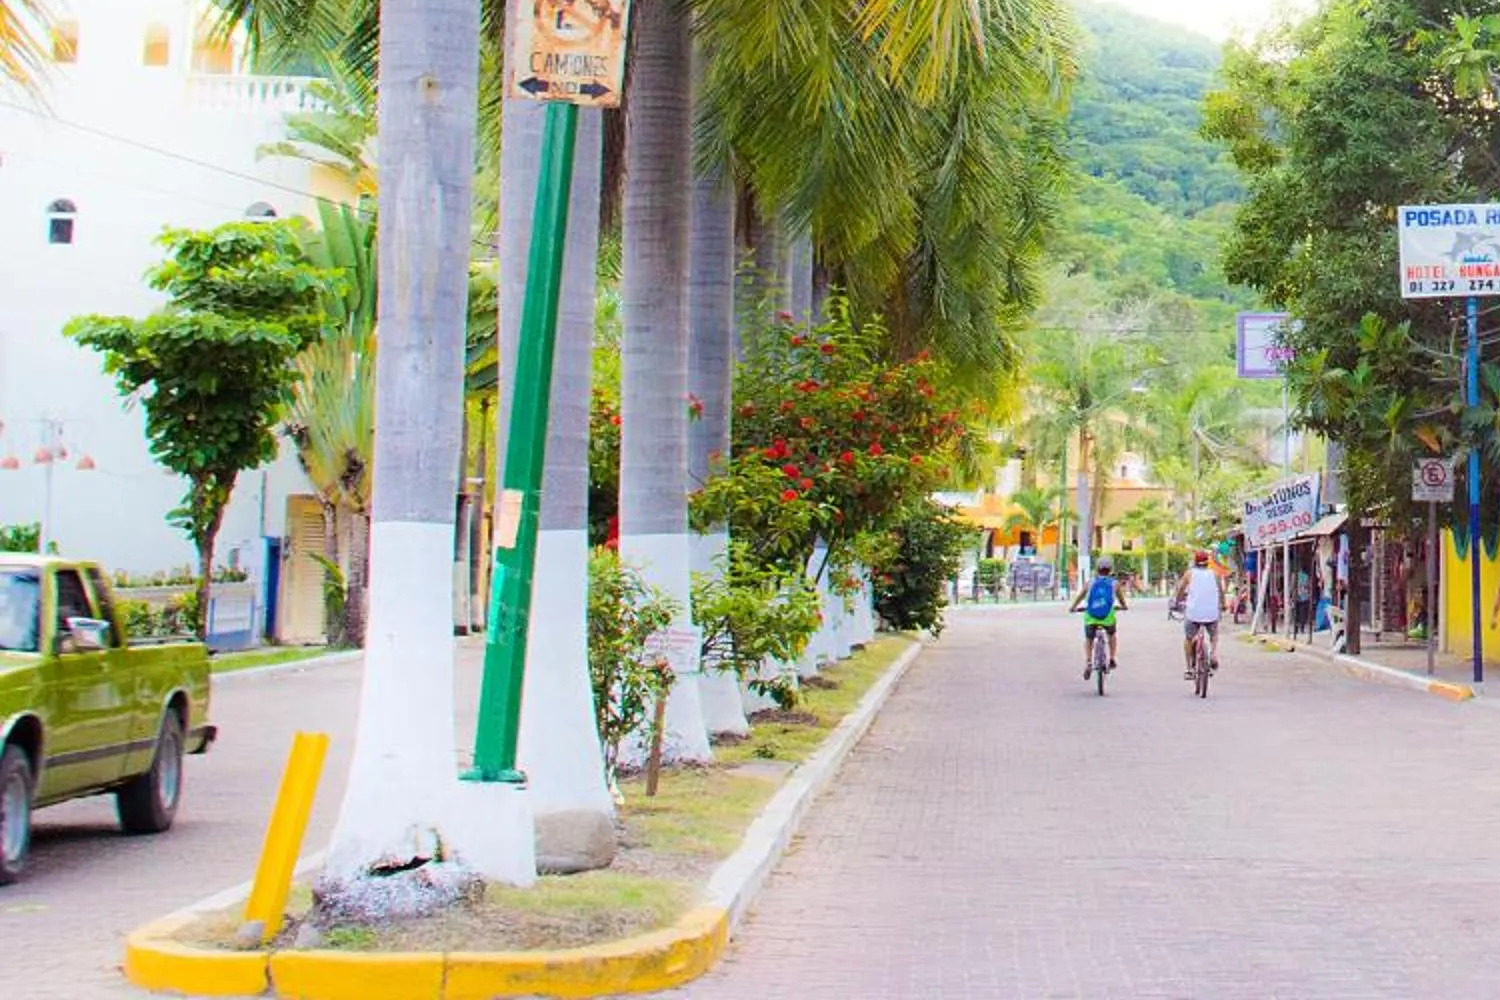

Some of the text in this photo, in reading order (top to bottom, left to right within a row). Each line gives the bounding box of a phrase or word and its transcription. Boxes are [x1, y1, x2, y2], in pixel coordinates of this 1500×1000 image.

[1405, 209, 1477, 227] POSADA
[1407, 265, 1446, 280] HOTEL
[1409, 281, 1423, 292] 01
[1469, 280, 1493, 291] 274
